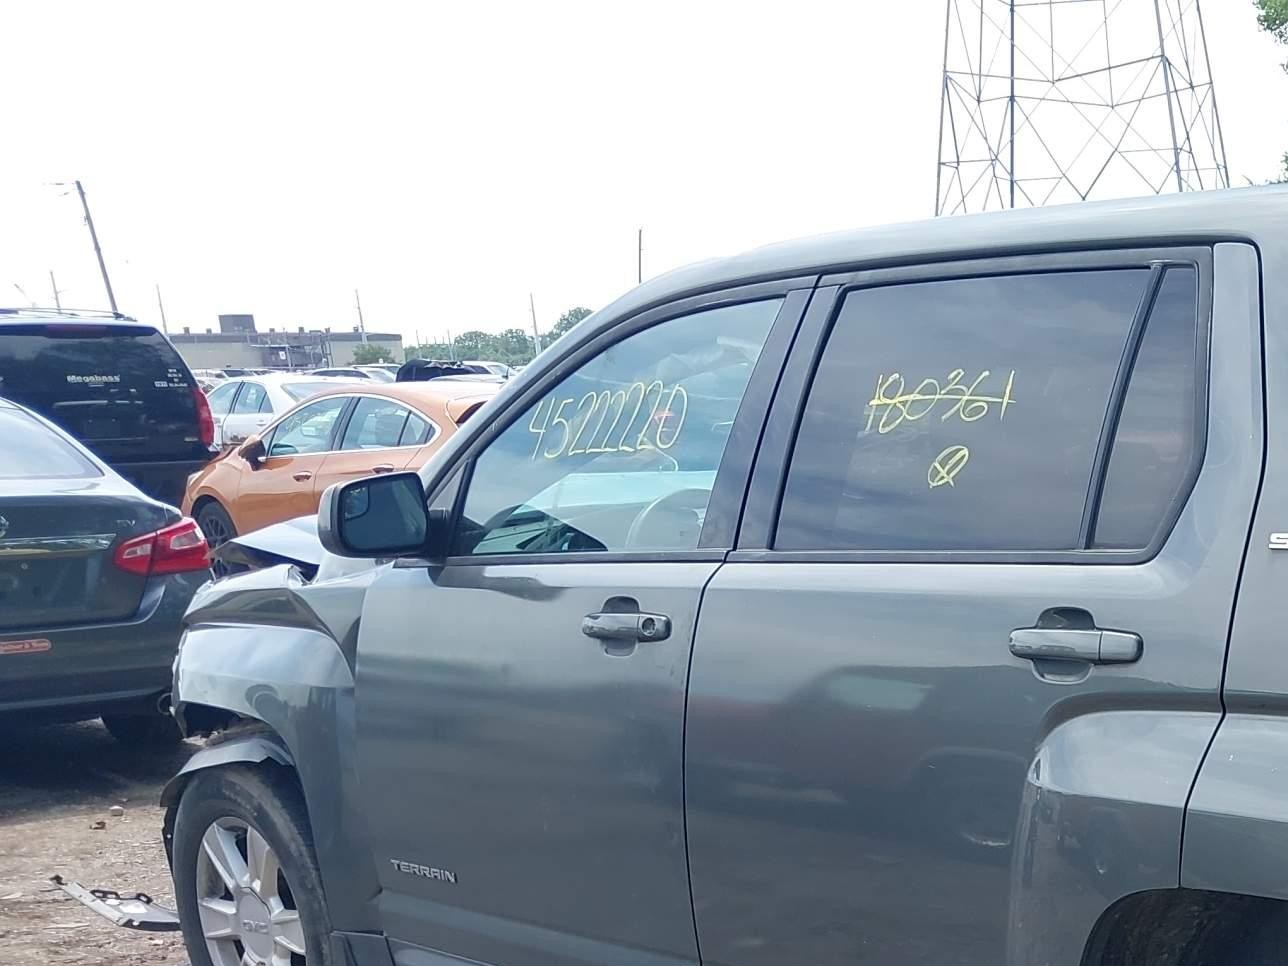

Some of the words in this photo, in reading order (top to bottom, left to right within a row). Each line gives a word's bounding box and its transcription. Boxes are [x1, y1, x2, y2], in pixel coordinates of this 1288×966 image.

[66, 374, 121, 382] Megabass
[863, 367, 1017, 434] 180361
[528, 379, 688, 461] 45222220
[389, 858, 459, 884] TERRAIN
